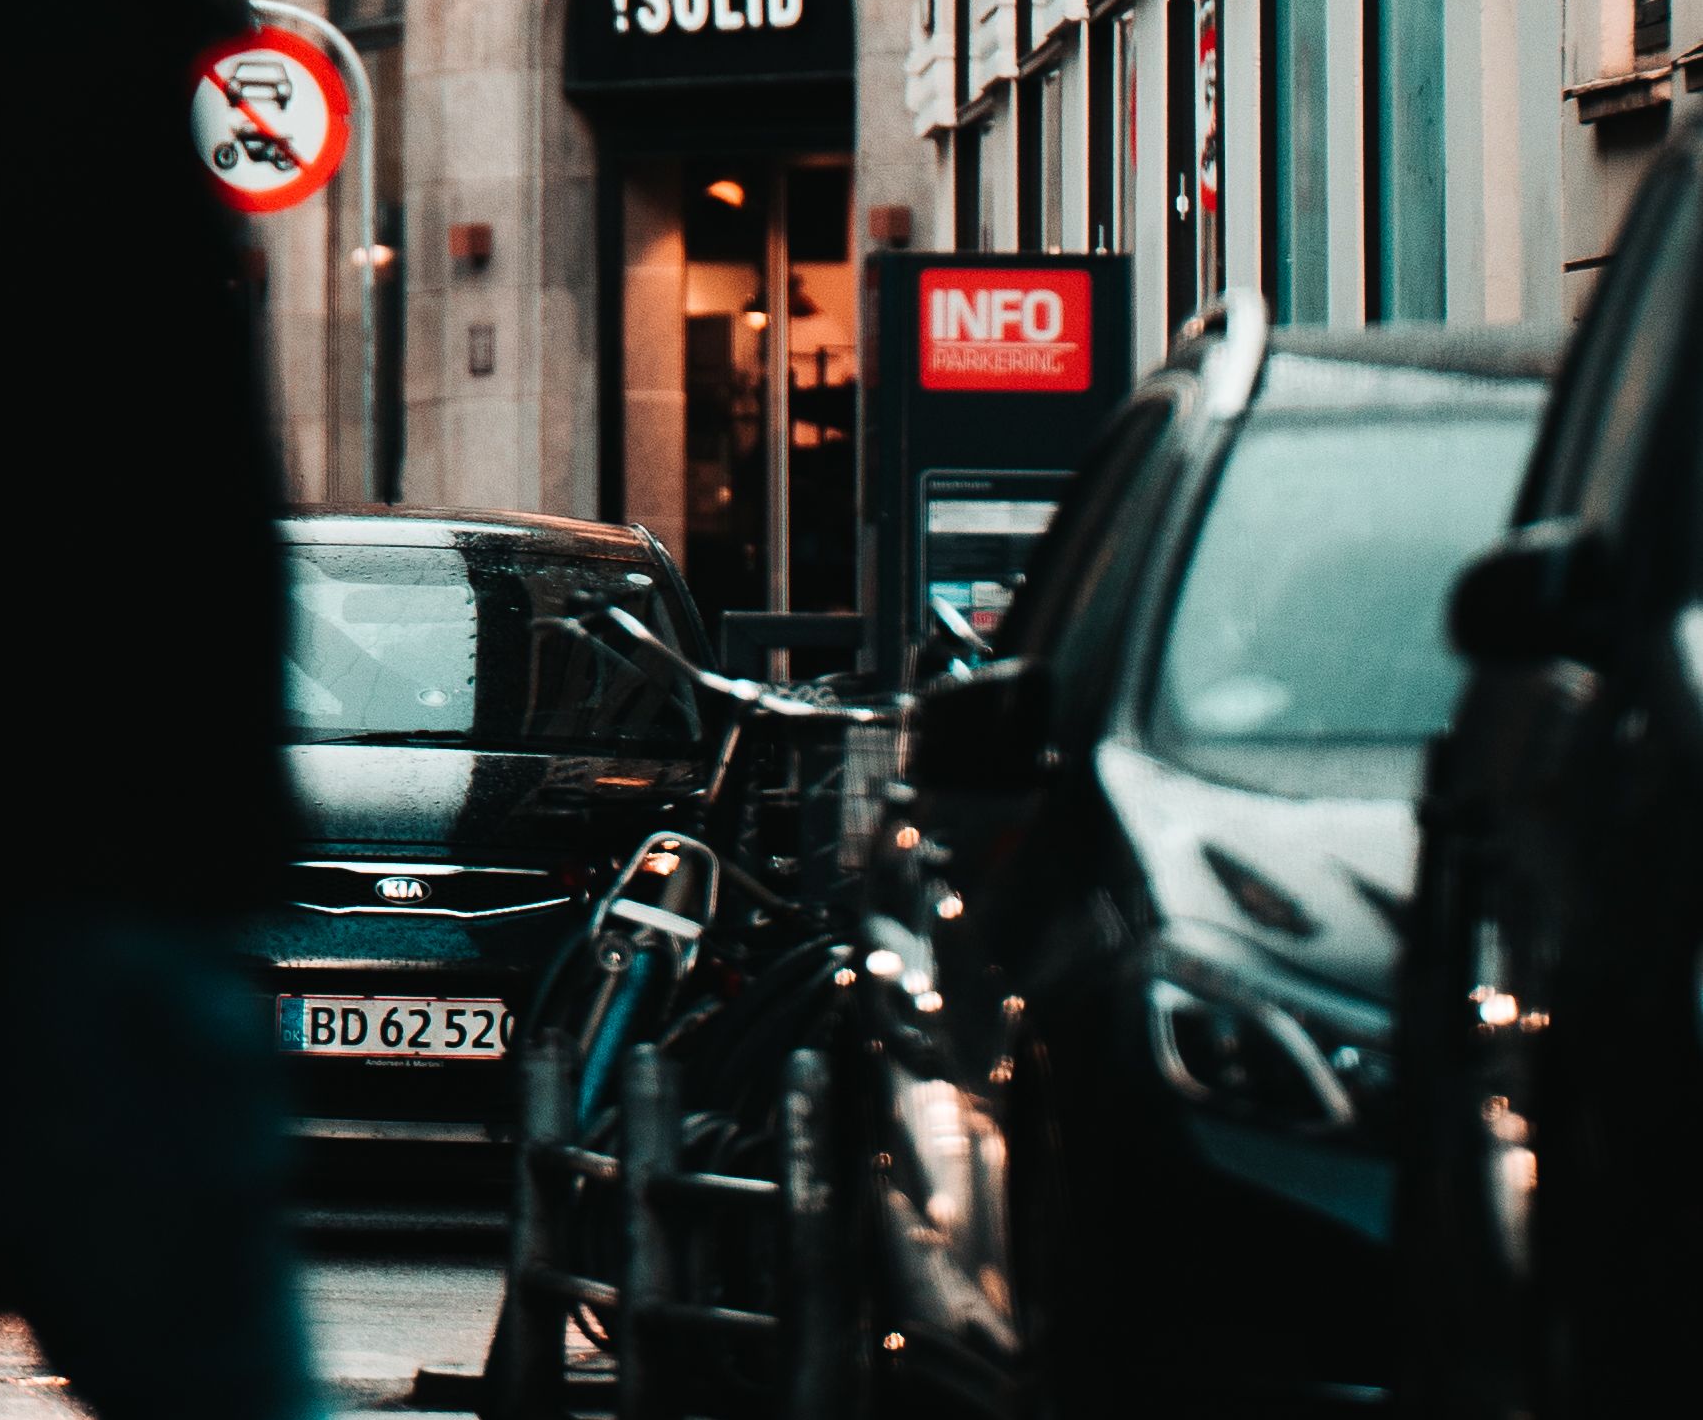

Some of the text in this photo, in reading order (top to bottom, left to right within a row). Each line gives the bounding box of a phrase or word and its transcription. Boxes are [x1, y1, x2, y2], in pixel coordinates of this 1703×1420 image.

[930, 288, 1065, 343] INFO
[931, 348, 1065, 374] PARKERING
[382, 879, 423, 898] KIA
[283, 1029, 300, 1042] DK
[310, 1007, 369, 1046] BD
[380, 1007, 432, 1049] 62
